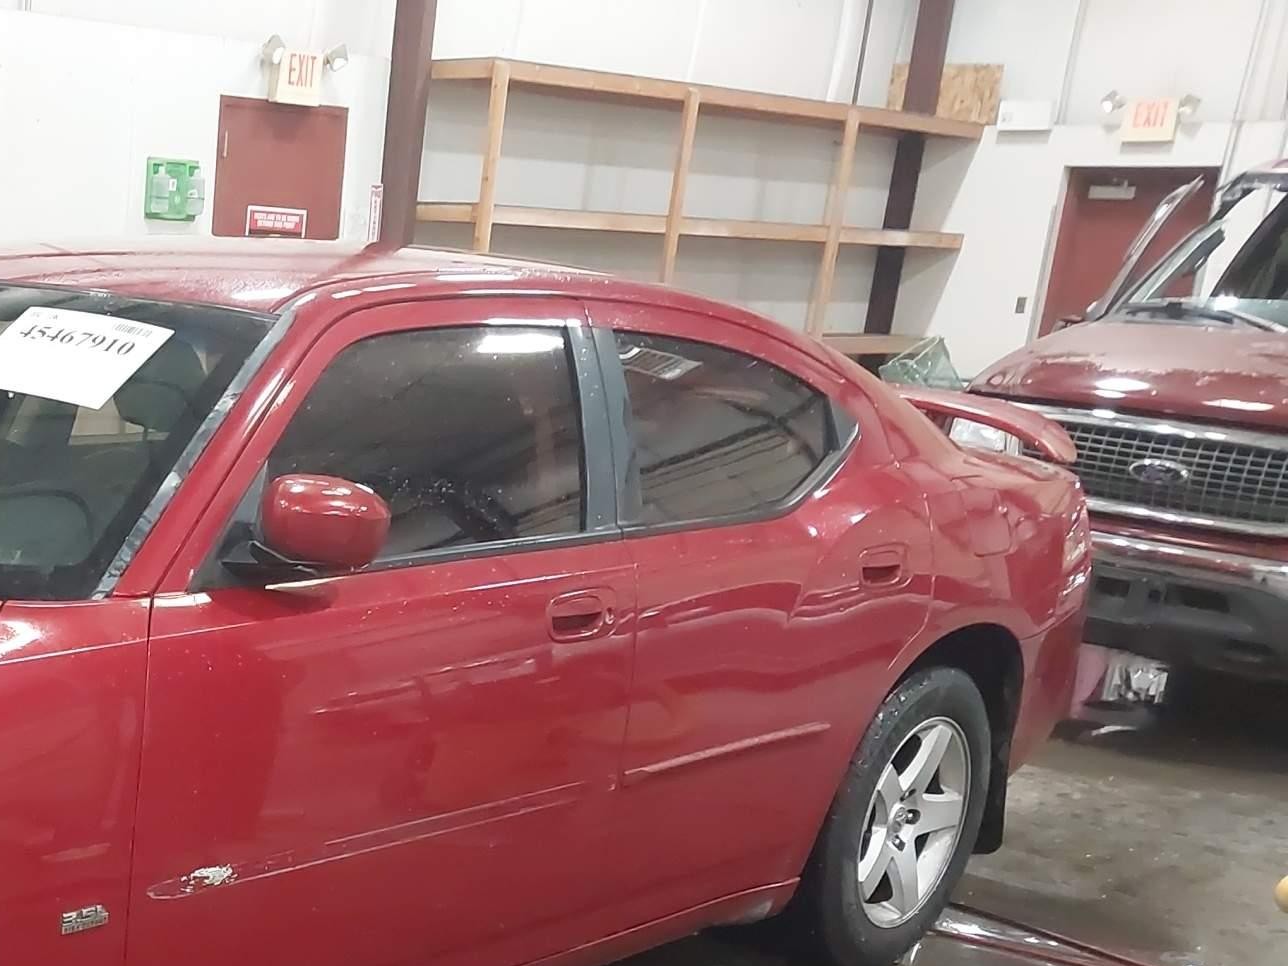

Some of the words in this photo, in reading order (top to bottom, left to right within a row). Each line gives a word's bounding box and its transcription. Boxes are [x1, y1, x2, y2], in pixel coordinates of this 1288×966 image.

[288, 53, 317, 88] EXIT
[1133, 101, 1169, 128] EXIT
[20, 325, 136, 355] 45467910
